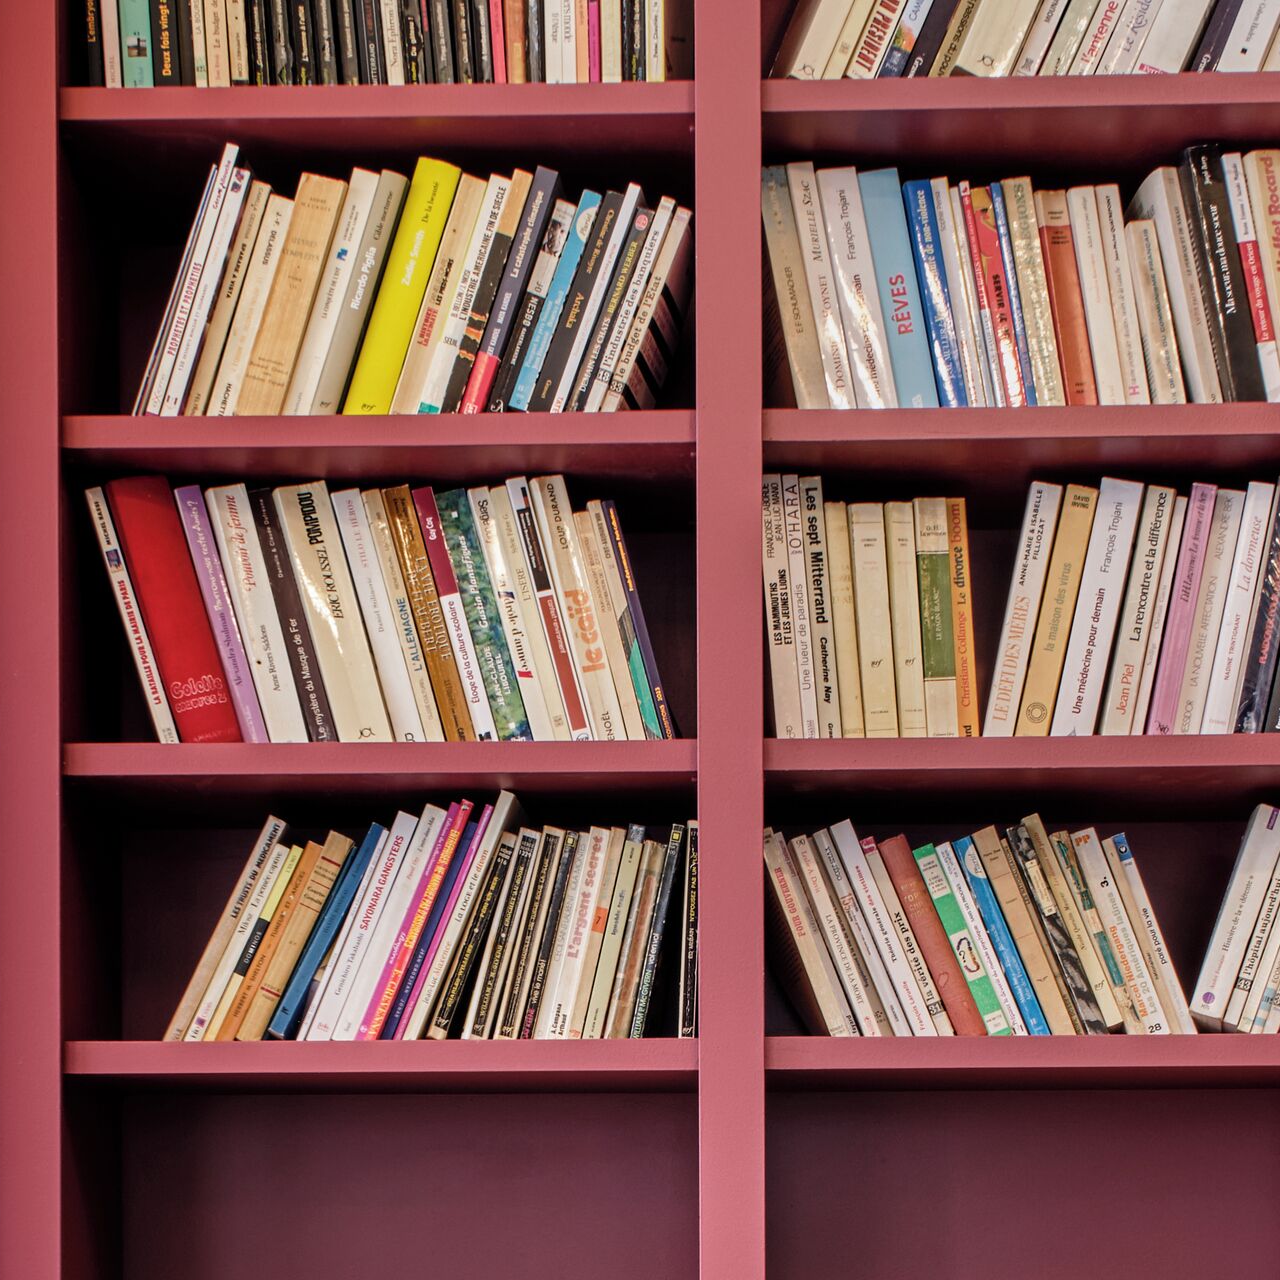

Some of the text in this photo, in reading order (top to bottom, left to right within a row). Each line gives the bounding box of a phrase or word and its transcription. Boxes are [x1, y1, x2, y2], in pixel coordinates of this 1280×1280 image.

[158, 4, 172, 76] Deux fois vingt
[1259, 156, 1280, 216] Rocard
[401, 229, 425, 286] Zadie Smith
[509, 190, 544, 278] La catastrophe climatique
[838, 189, 856, 260] François Trojani
[349, 245, 379, 310] Ricardo Piglia
[602, 230, 659, 367] l'industrie des banquiers
[888, 274, 913, 335] RÊVES
[614, 276, 661, 378] le budget de l'Etat
[785, 484, 802, 549] O'HARA
[1099, 501, 1123, 573] François Trojani
[296, 490, 344, 620] ERIC ROUSSEL POMPIDOU
[804, 487, 828, 624] Les sept Mitterrand
[1129, 492, 1167, 642] La rencontre et la différence
[396, 597, 423, 671] L'ALLEMAGNE
[563, 587, 605, 673] le caïd
[769, 582, 783, 645] LES MAMMOUTHS
[777, 569, 792, 645] ET LES JEUNES LIONS
[948, 503, 970, 706] Christiane Collange Le divorce boom
[260, 624, 281, 691] Anne Rivers Siddons
[289, 618, 327, 741] Le mystère du Masque de Fer
[447, 600, 480, 704] Éloge de la culture scolaire
[1071, 587, 1106, 714] Une médecine pour demain
[1116, 663, 1134, 715] Jean Piel
[359, 835, 404, 931] SAYONARA GANGSTERS
[566, 834, 603, 960] L'argent secret
[893, 911, 909, 934] prix
[904, 936, 915, 954] des
[1243, 935, 1263, 975] l'hôpital
[910, 956, 929, 987] vérité
[921, 989, 934, 1003] la
[1107, 924, 1149, 1018] Marcel Niedergang
